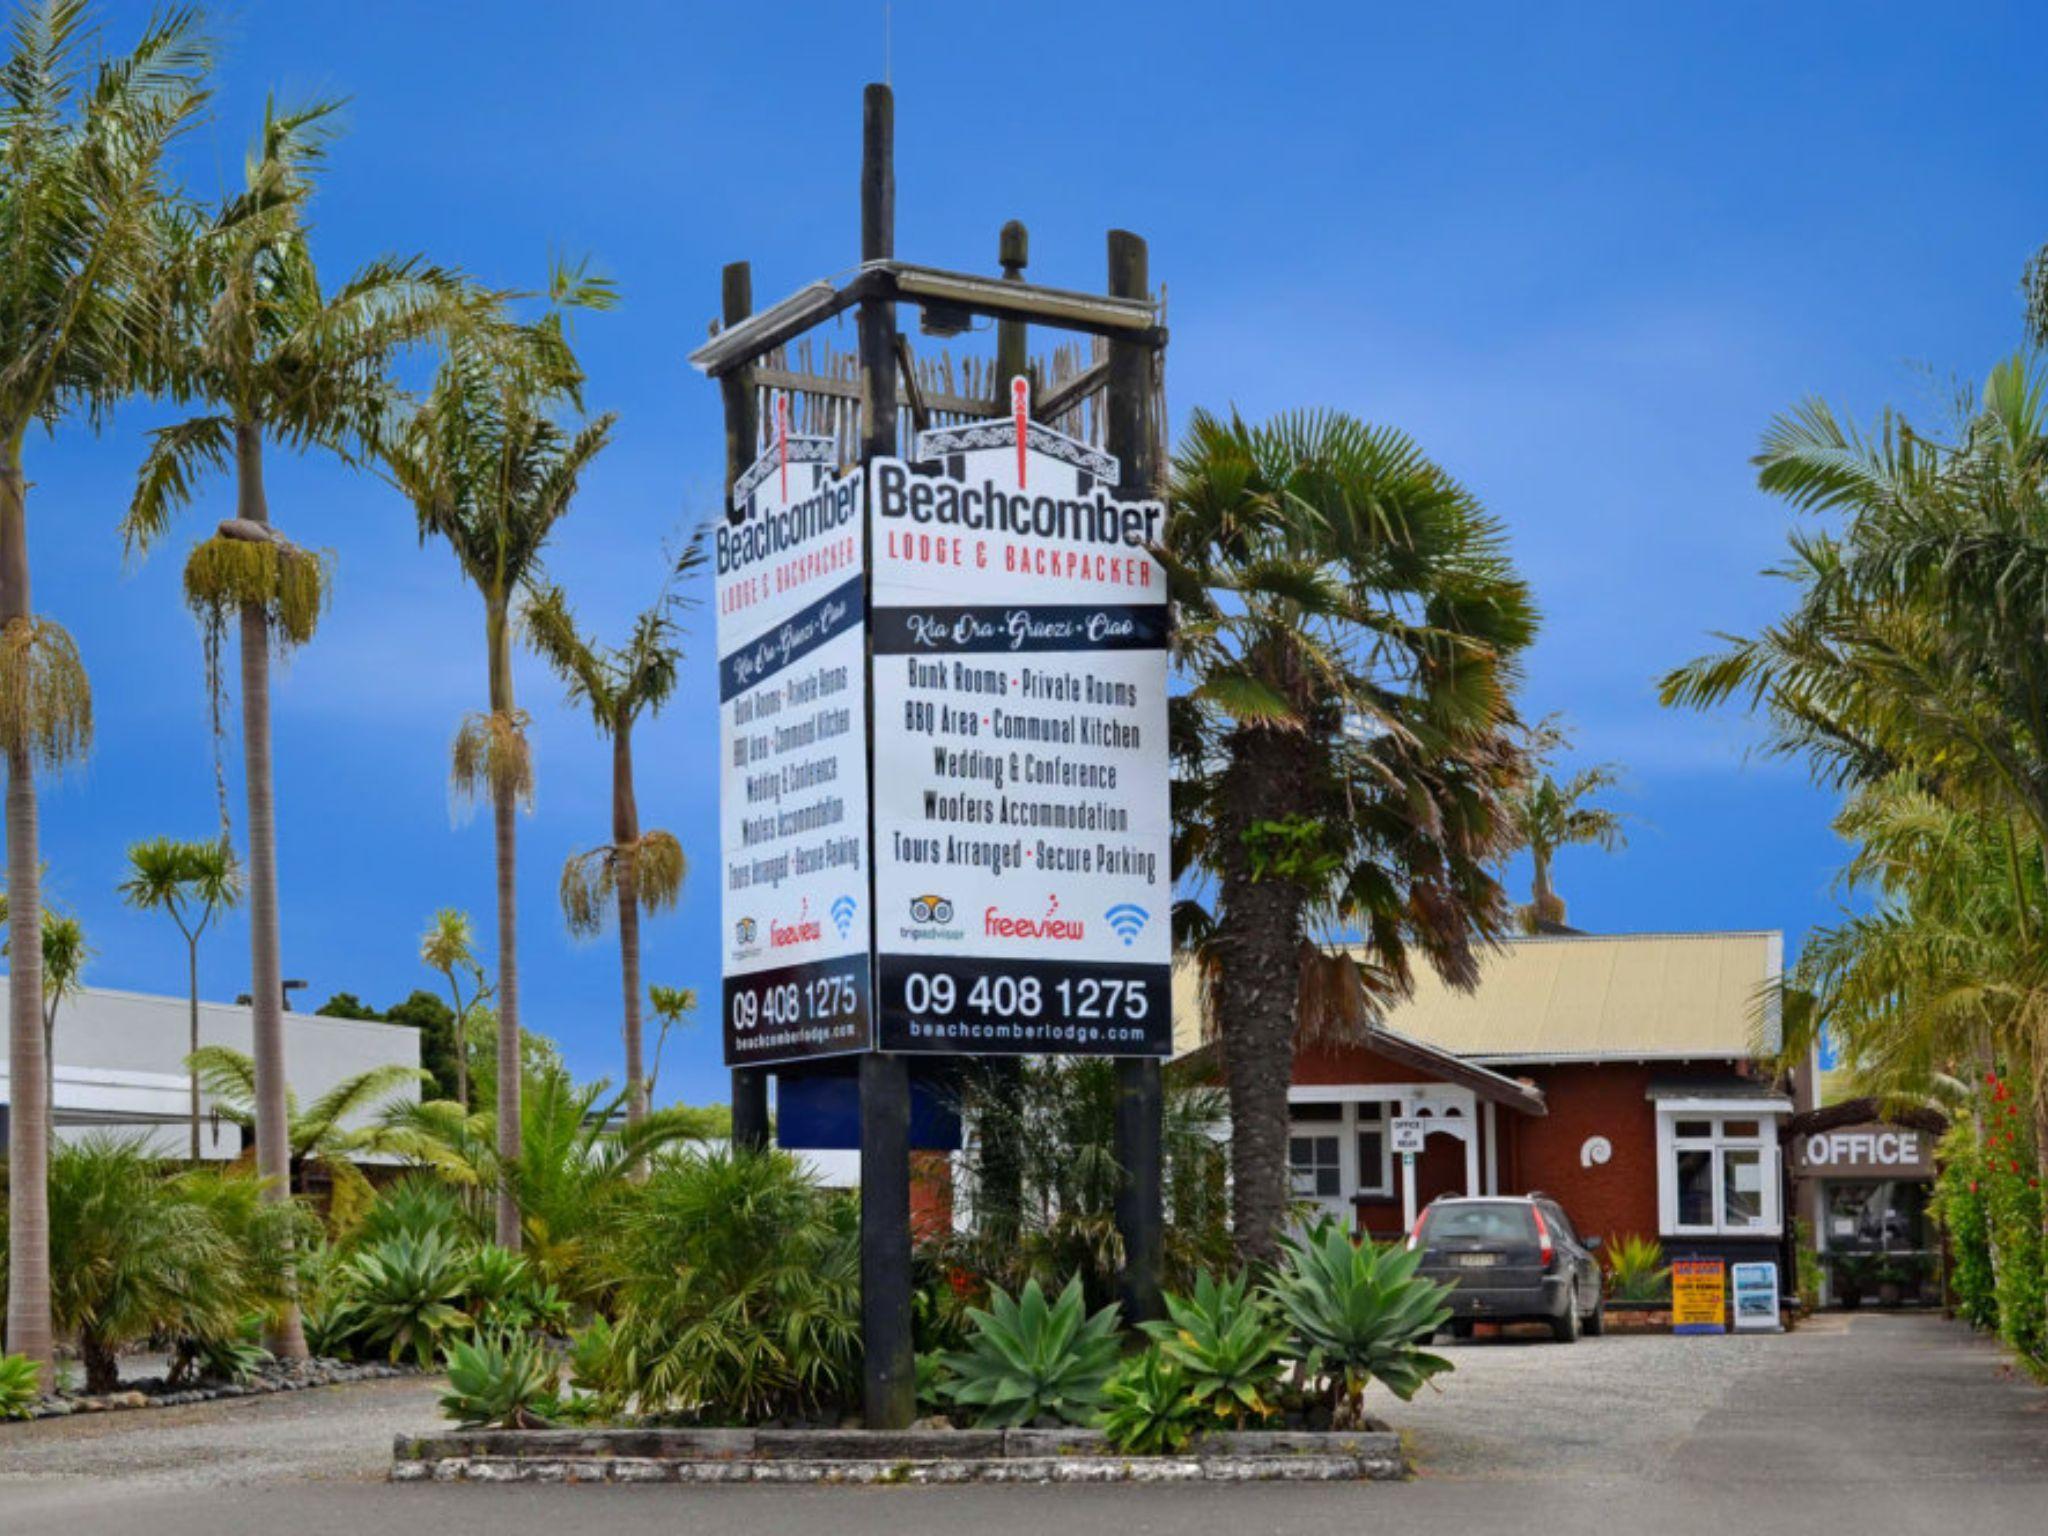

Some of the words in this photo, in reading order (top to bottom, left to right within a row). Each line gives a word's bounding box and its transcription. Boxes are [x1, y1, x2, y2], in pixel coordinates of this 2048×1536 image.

[717, 476, 859, 575] Beachcomber
[879, 464, 1160, 547] Beachcomber
[722, 578, 757, 615] LODGE
[776, 536, 854, 593] BACKPACKER
[888, 530, 961, 566] LODGE
[976, 541, 987, 568] &
[1006, 544, 1149, 588] BACKPACKER
[907, 614, 947, 646] Kia
[953, 613, 995, 644] Ora
[1086, 613, 1133, 641] Ciao
[909, 657, 947, 690] Bunk
[955, 661, 1008, 696] Rooms
[1022, 668, 1080, 702] Private
[1086, 674, 1137, 707] Rooms
[905, 700, 934, 736] BBQ
[942, 704, 978, 736] Area
[993, 707, 1075, 744] Communal
[1081, 716, 1140, 748] Kitchen
[934, 746, 1003, 789] Wedding
[1009, 752, 1018, 782] &
[1025, 753, 1116, 789] Conference
[924, 791, 993, 824] Woofers
[1000, 795, 1127, 831] Accommodation
[893, 831, 940, 864] Tours
[946, 835, 1021, 876] Arranged
[1036, 839, 1090, 872] Secure
[1096, 844, 1155, 884] Parking
[984, 894, 1084, 940] freeview
[733, 990, 757, 1030] 09
[762, 983, 799, 1024] 408
[805, 974, 857, 1019] 1275
[905, 973, 956, 1015] 09
[967, 976, 1041, 1017] 408
[1055, 979, 1148, 1019] 1275
[909, 1021, 1145, 1041] beachcomberlodge.com
[1807, 1133, 1919, 1165] OFFICE
